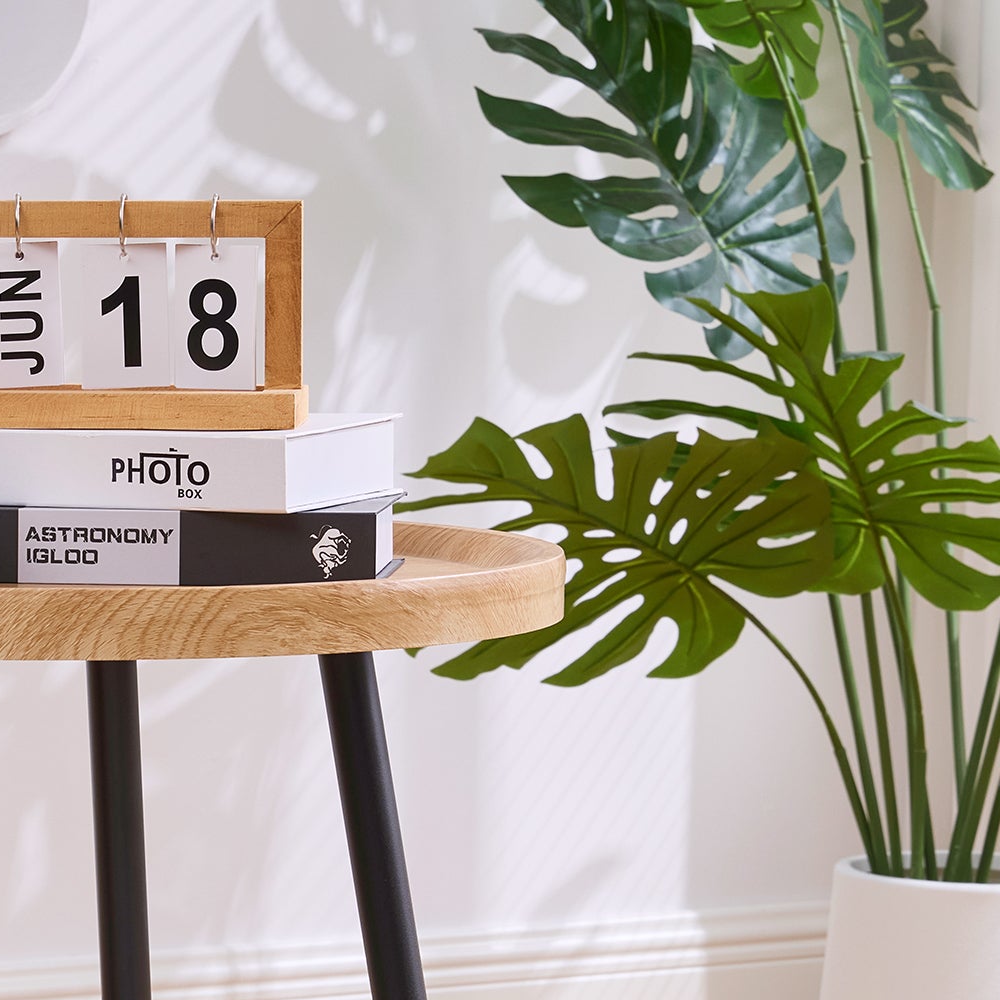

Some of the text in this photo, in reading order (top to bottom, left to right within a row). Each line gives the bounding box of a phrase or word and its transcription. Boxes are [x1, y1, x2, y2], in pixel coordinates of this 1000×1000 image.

[111, 451, 210, 486] PHOTO
[177, 489, 203, 499] BOX
[25, 526, 174, 544] ASTRONOMY
[26, 548, 99, 564] IGLOO
